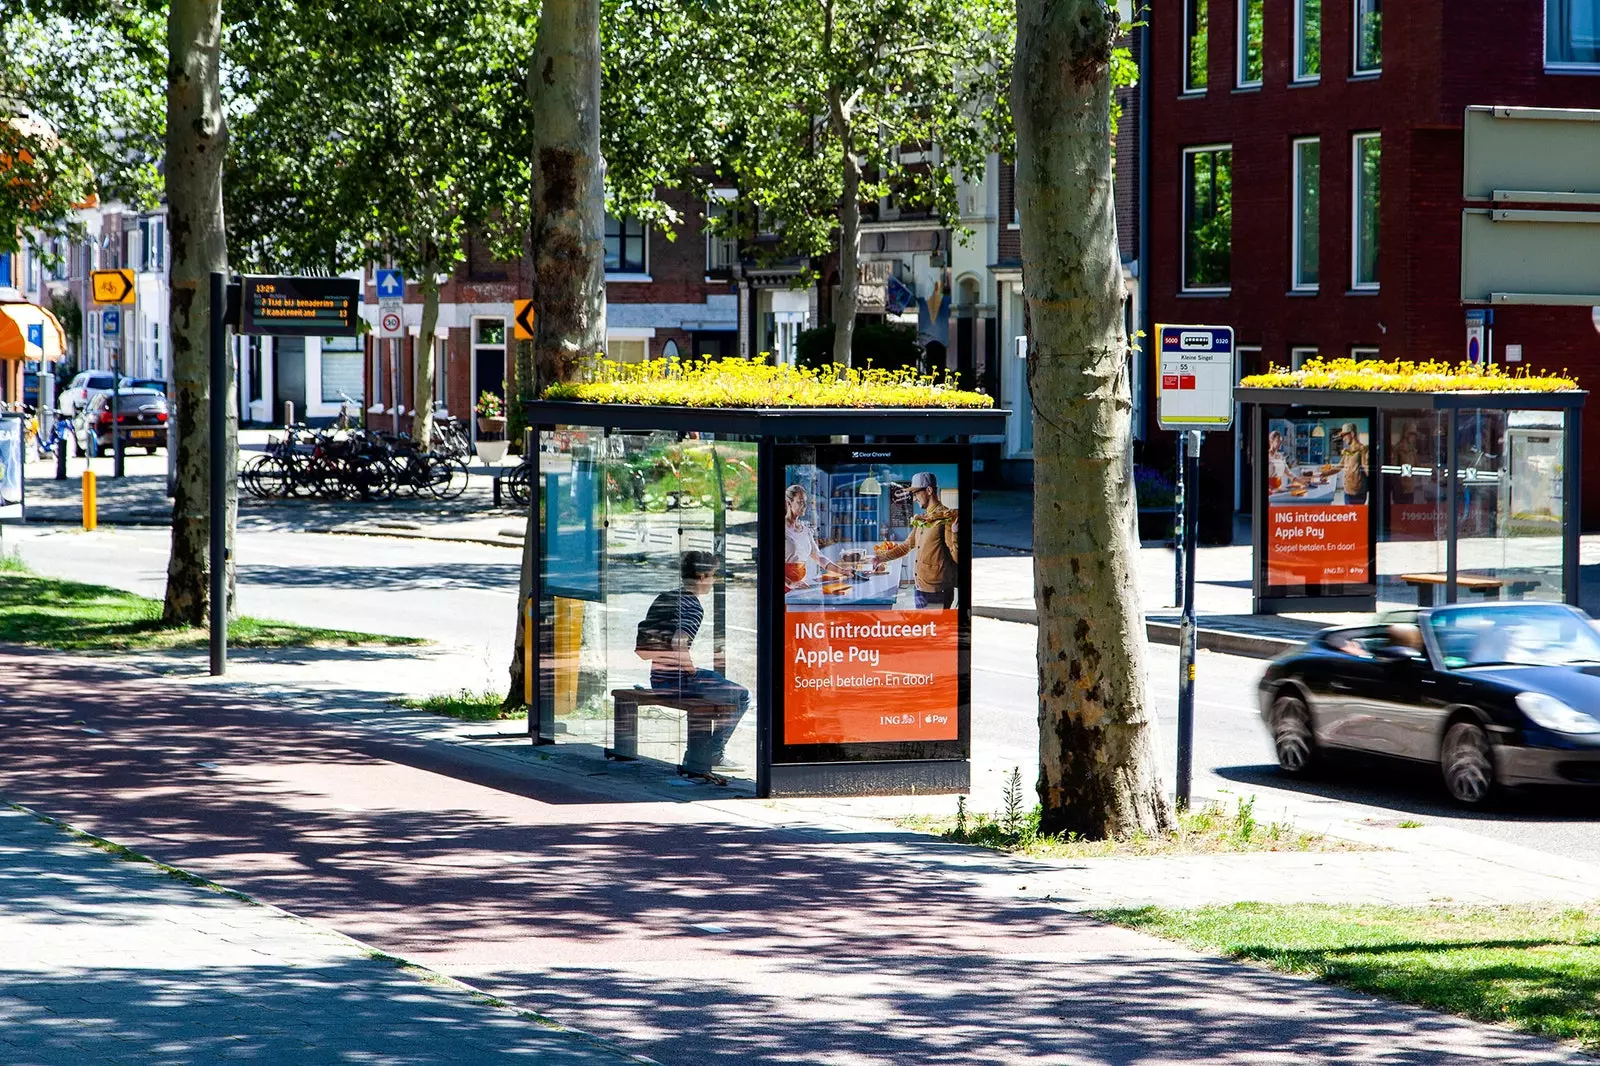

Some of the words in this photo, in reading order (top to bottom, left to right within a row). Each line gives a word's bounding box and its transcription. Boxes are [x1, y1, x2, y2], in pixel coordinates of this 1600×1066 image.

[268, 298, 282, 307] Tijd
[284, 298, 294, 307] bij
[386, 319, 397, 327] 30
[1198, 354, 1213, 362] Singel
[1275, 512, 1293, 523] ING
[1295, 511, 1357, 523] introduceert
[1275, 527, 1303, 540] Apple
[1306, 527, 1325, 539] Pay
[1275, 543, 1298, 553] Soepel
[1327, 543, 1336, 551] En
[795, 622, 825, 640] ING
[830, 621, 937, 639] introduceert
[795, 648, 844, 668] Apple
[849, 646, 880, 667] Pay
[795, 675, 834, 690] Soepel
[836, 674, 884, 688] betalen.
[885, 674, 900, 686] En
[902, 673, 934, 686] door!
[880, 715, 900, 725] ING
[932, 714, 948, 725] Pay
